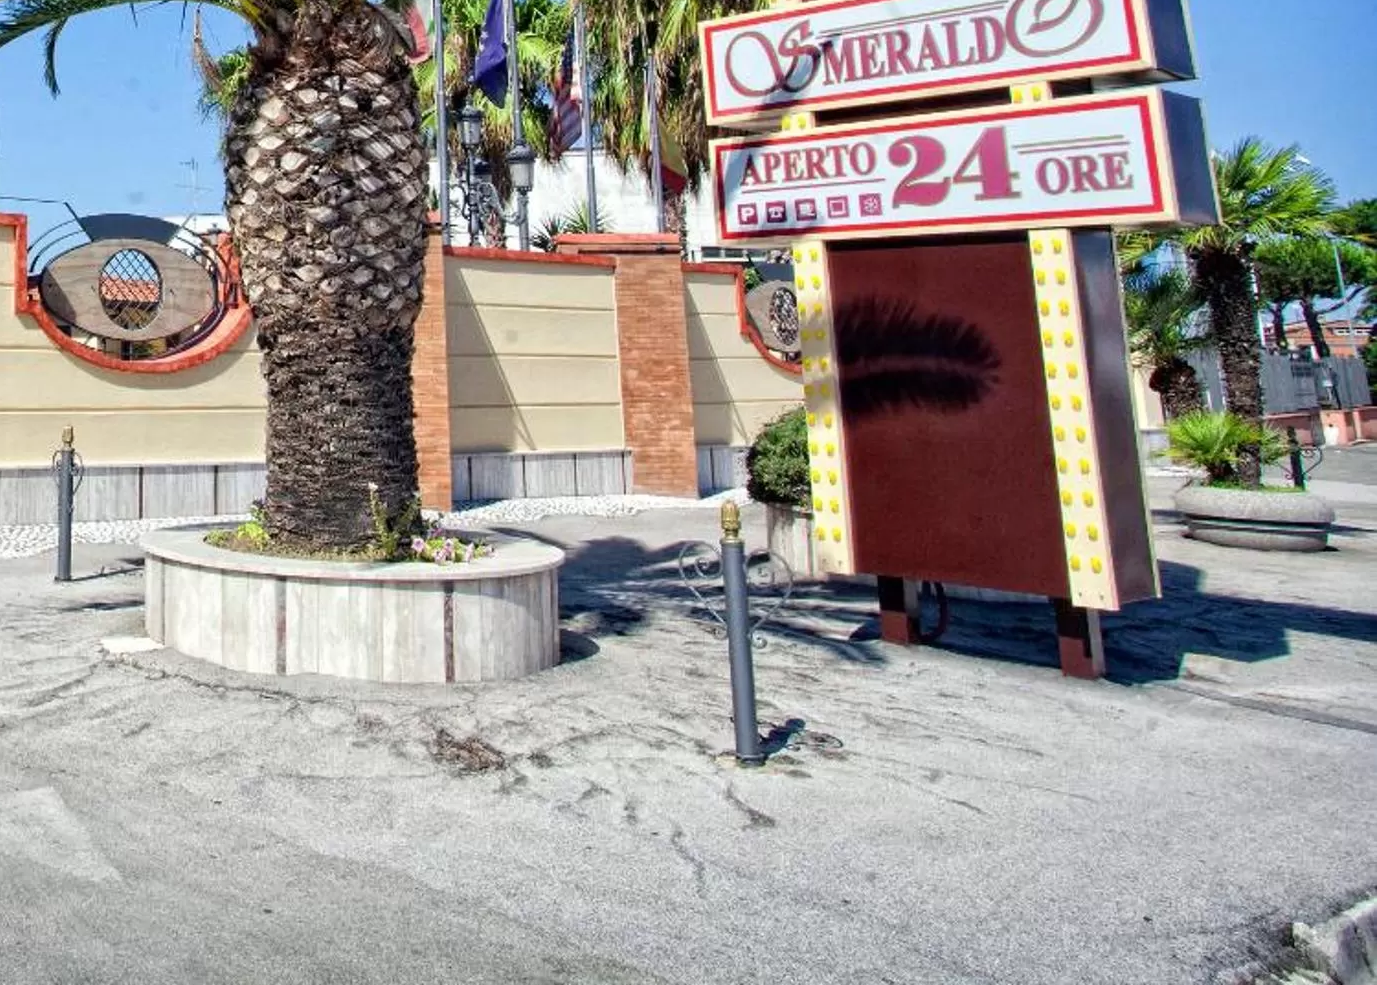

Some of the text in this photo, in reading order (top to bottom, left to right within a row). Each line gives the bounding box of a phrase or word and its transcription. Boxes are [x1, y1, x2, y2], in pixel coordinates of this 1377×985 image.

[740, 125, 1135, 209] APERTO 24 ORE
